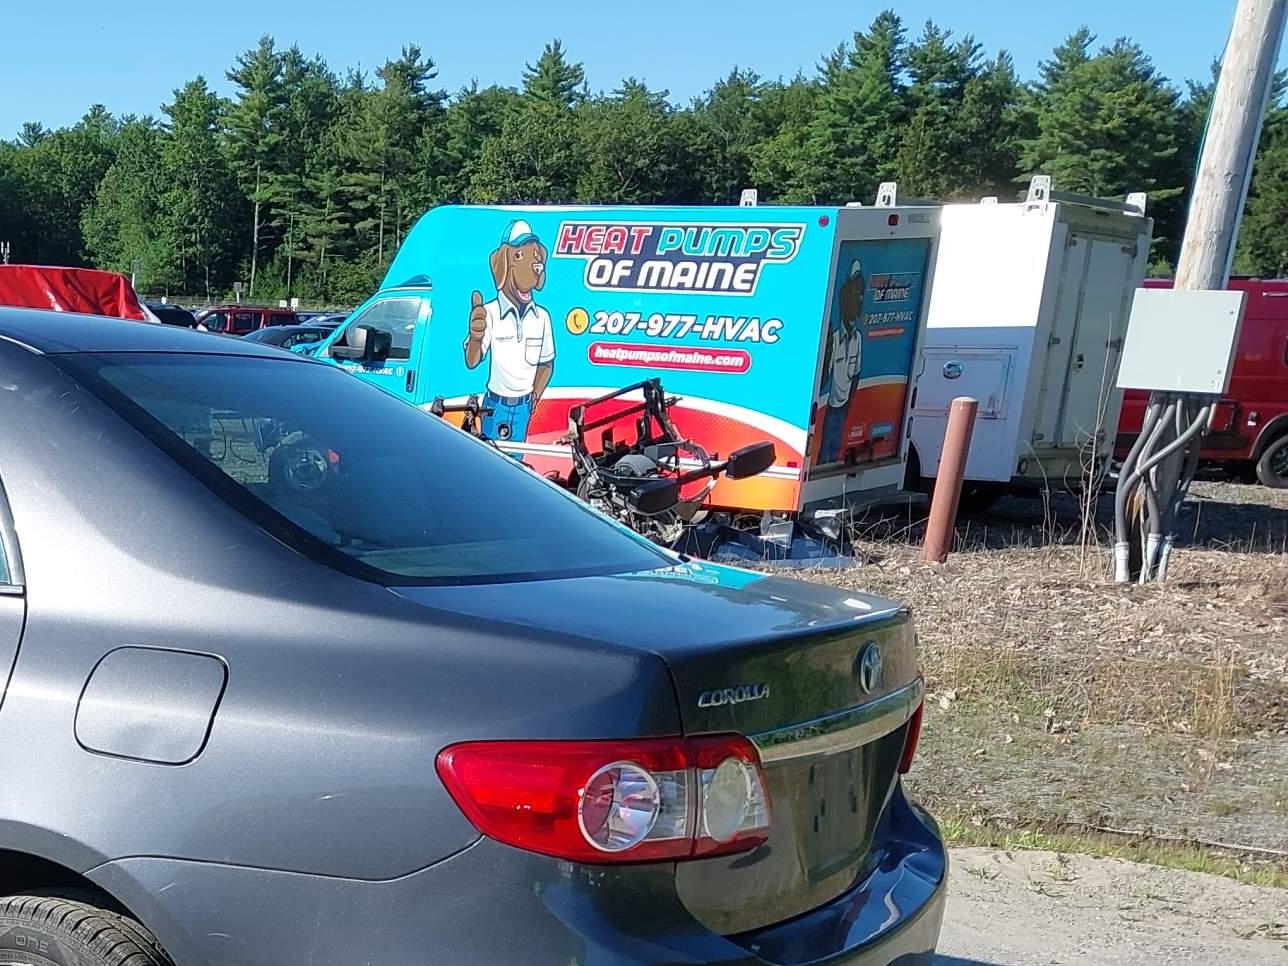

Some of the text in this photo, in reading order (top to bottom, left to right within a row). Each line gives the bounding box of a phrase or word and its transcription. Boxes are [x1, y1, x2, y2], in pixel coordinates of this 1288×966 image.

[558, 225, 798, 257] HEAT PUMPS
[589, 259, 758, 290] OF MAINE
[590, 311, 784, 343] 207-977-HVAC
[594, 346, 744, 367] heatpumpsofmaine.com
[698, 684, 770, 708] COROLLA
